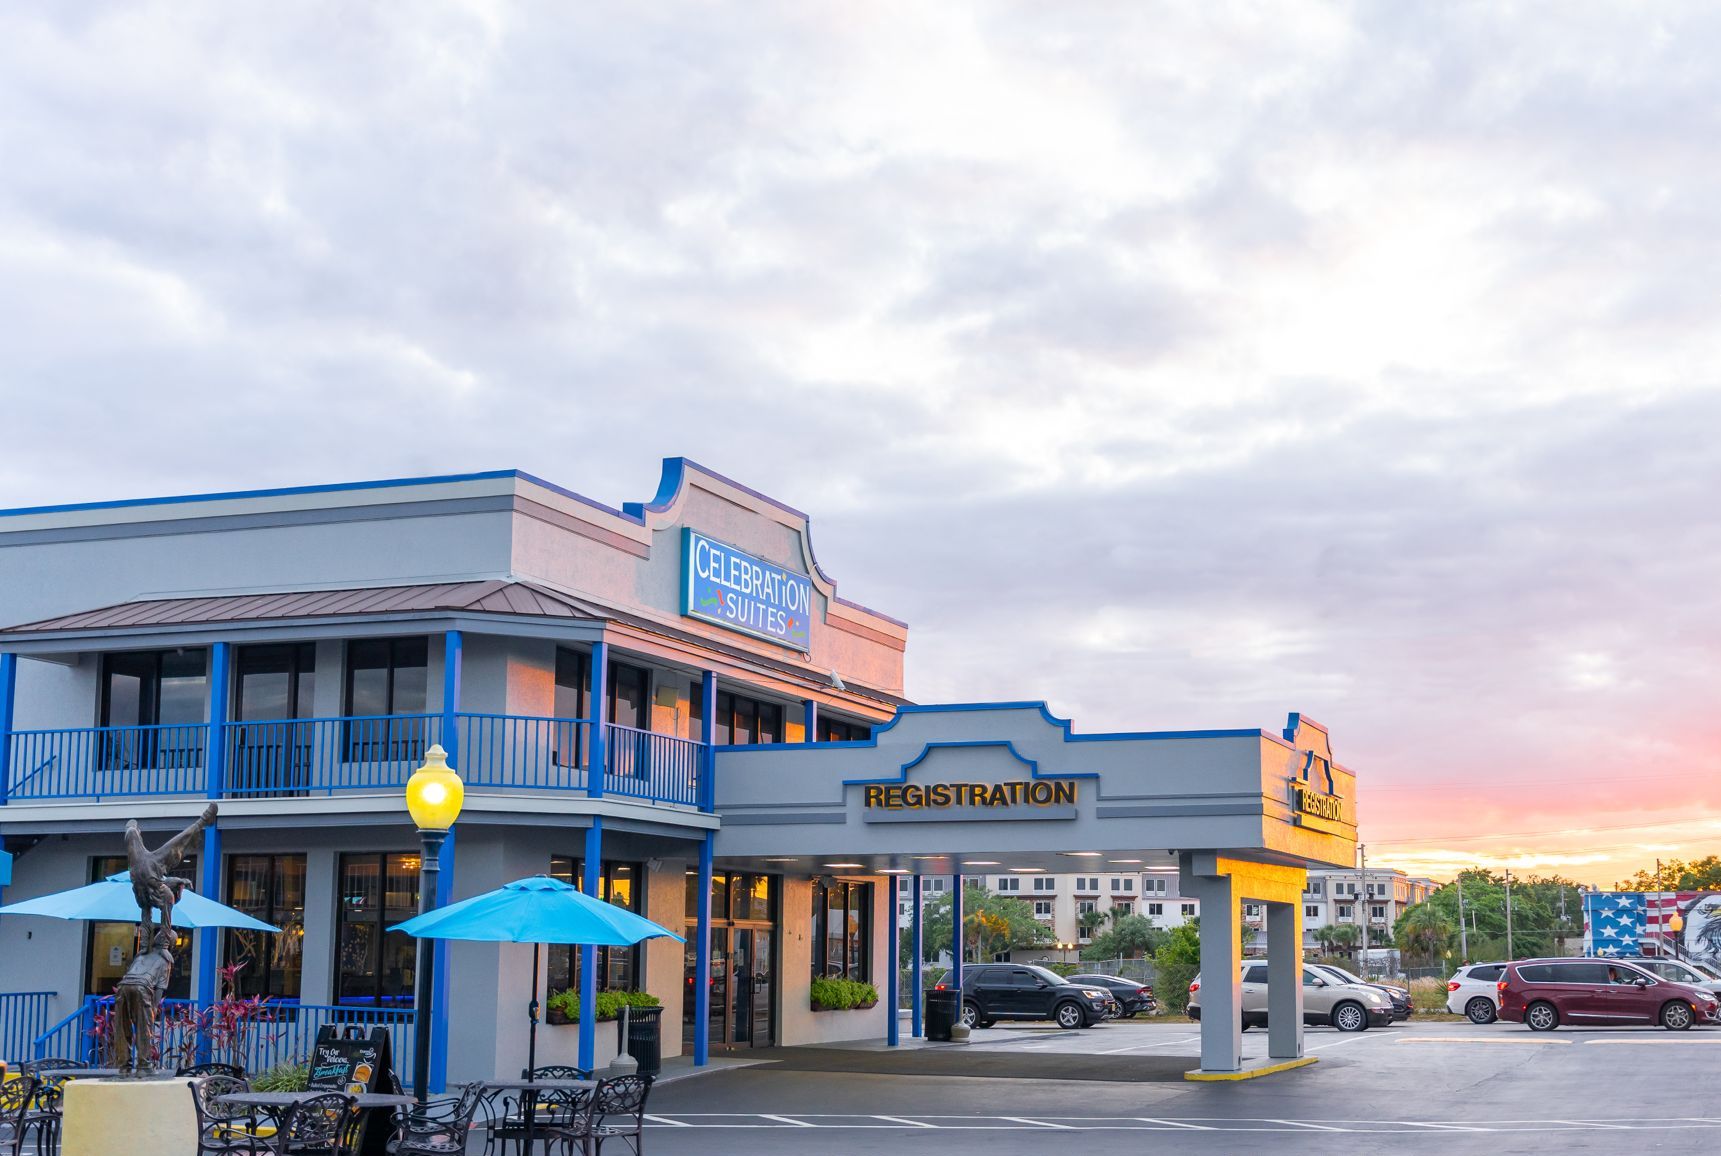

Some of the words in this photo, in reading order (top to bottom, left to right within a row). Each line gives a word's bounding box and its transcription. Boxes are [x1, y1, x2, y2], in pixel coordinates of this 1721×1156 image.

[726, 593, 786, 635] SUITES
[864, 781, 1077, 809] REGISTRATION
[1302, 789, 1342, 822] REGISTRATION
[319, 1047, 330, 1058] Try
[314, 1064, 351, 1078] Breakfast
